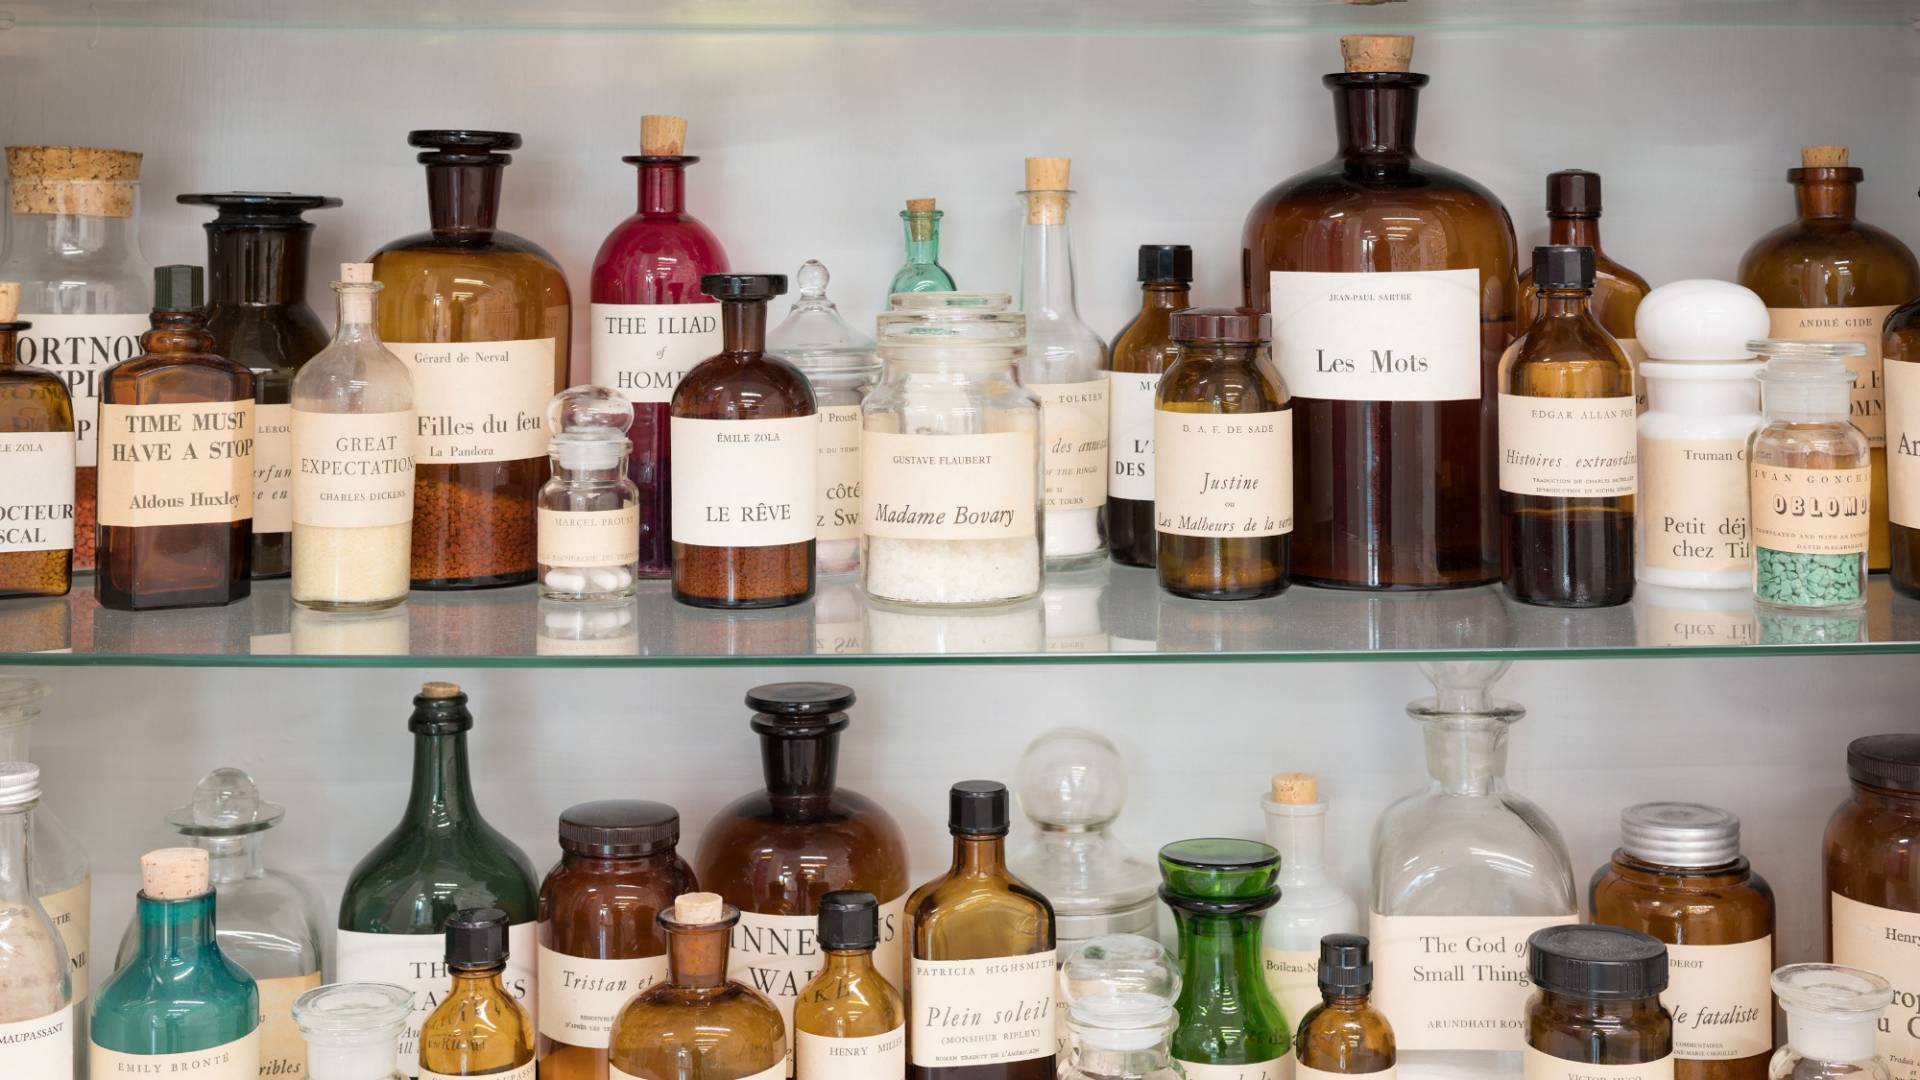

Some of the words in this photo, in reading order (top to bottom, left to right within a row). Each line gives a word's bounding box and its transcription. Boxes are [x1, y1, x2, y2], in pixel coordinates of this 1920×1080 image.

[1329, 293, 1375, 301] JEAN-PAUL
[1379, 293, 1412, 301] SARTRE
[605, 317, 647, 334] THE
[658, 316, 716, 334] ILIAD
[1800, 318, 1839, 328] ANDRÉ
[1845, 318, 1873, 327] GIDE
[17, 335, 144, 365] ORTNO
[415, 352, 451, 364] Gérard
[457, 353, 469, 363] de
[475, 351, 509, 363] Nerval
[656, 346, 667, 359] of
[1316, 349, 1355, 373] Les
[1370, 349, 1428, 373] Mots
[1059, 393, 1103, 403] TOLKIEN
[126, 414, 181, 433] TIME
[192, 411, 246, 432] MUST
[829, 413, 858, 422] Proust
[1531, 410, 1573, 420] EDGAR
[1580, 410, 1617, 420] ALLAN
[258, 425, 291, 434] LEROU
[417, 415, 474, 436] Filles
[483, 414, 507, 433] du
[517, 411, 541, 431] feu
[1183, 424, 1191, 433] D.
[1198, 426, 1207, 434] A.
[1227, 426, 1242, 434] DE
[1248, 424, 1274, 434] SADE
[336, 436, 397, 451] GREAT
[717, 432, 750, 443] ÉMILE
[754, 432, 780, 442] ZOLA
[1052, 437, 1072, 453] des
[16, 444, 43, 452] ZOLA
[112, 442, 171, 462] HAVE
[182, 442, 202, 460] A
[209, 439, 253, 460] STOP
[430, 446, 443, 457] La
[450, 445, 494, 457] Pandora
[1683, 450, 1733, 461] Truman
[893, 456, 935, 465] GUSTAVE
[939, 455, 992, 465] FLAUBERT
[1506, 448, 1562, 468] Histoires
[1115, 461, 1145, 477] DES
[1755, 469, 1792, 482] IVAN
[826, 481, 860, 500] côté
[1200, 472, 1259, 494] Justine
[129, 495, 184, 509] Aldous
[191, 491, 240, 509] Huxley
[320, 491, 365, 501] CHARLES
[369, 490, 406, 501] DICKENS
[705, 506, 730, 522] LE
[741, 502, 791, 522] RÊVE
[1773, 493, 1868, 518] OBLOMO
[555, 518, 598, 527] MARCEL
[875, 503, 946, 525] Madame
[953, 506, 1014, 528] Bovary
[1158, 512, 1171, 528] Les
[1178, 515, 1235, 532] Malheurs
[1244, 518, 1257, 531] de
[1264, 516, 1274, 530] la
[0, 528, 46, 544] SCAL
[1664, 516, 1706, 535] Petit
[1718, 518, 1746, 540] déj
[1673, 540, 1714, 558] chez
[53, 912, 71, 925] TIE
[1419, 936, 1457, 953] The
[1466, 936, 1506, 953] God
[1514, 941, 1528, 958] of
[917, 967, 976, 977] PATRICIA
[986, 959, 1055, 975] HIGHSMITH
[1266, 959, 1318, 973] Boileau-N
[1669, 959, 1704, 969] DEROT
[563, 970, 627, 992] Tristan
[638, 975, 653, 990] et
[1413, 965, 1464, 982] Small
[1472, 965, 1530, 987] Thing
[926, 1006, 982, 1027] Plein
[993, 997, 1050, 1025] soleil
[1672, 1004, 1688, 1023] le
[1691, 1004, 1759, 1029] fataliste
[1427, 1020, 1496, 1029] ARUNDHATI
[1501, 1020, 1525, 1029] ROY
[0, 1022, 65, 1045] MAUPASSANT
[941, 1033, 998, 1045] (MONSIEUR
[1003, 1029, 1041, 1041] RIPLEY)
[829, 1047, 868, 1056] HENRY
[118, 1062, 161, 1073] EMILY
[171, 1052, 230, 1072] BRONTË
[259, 1059, 301, 1076] ribles
